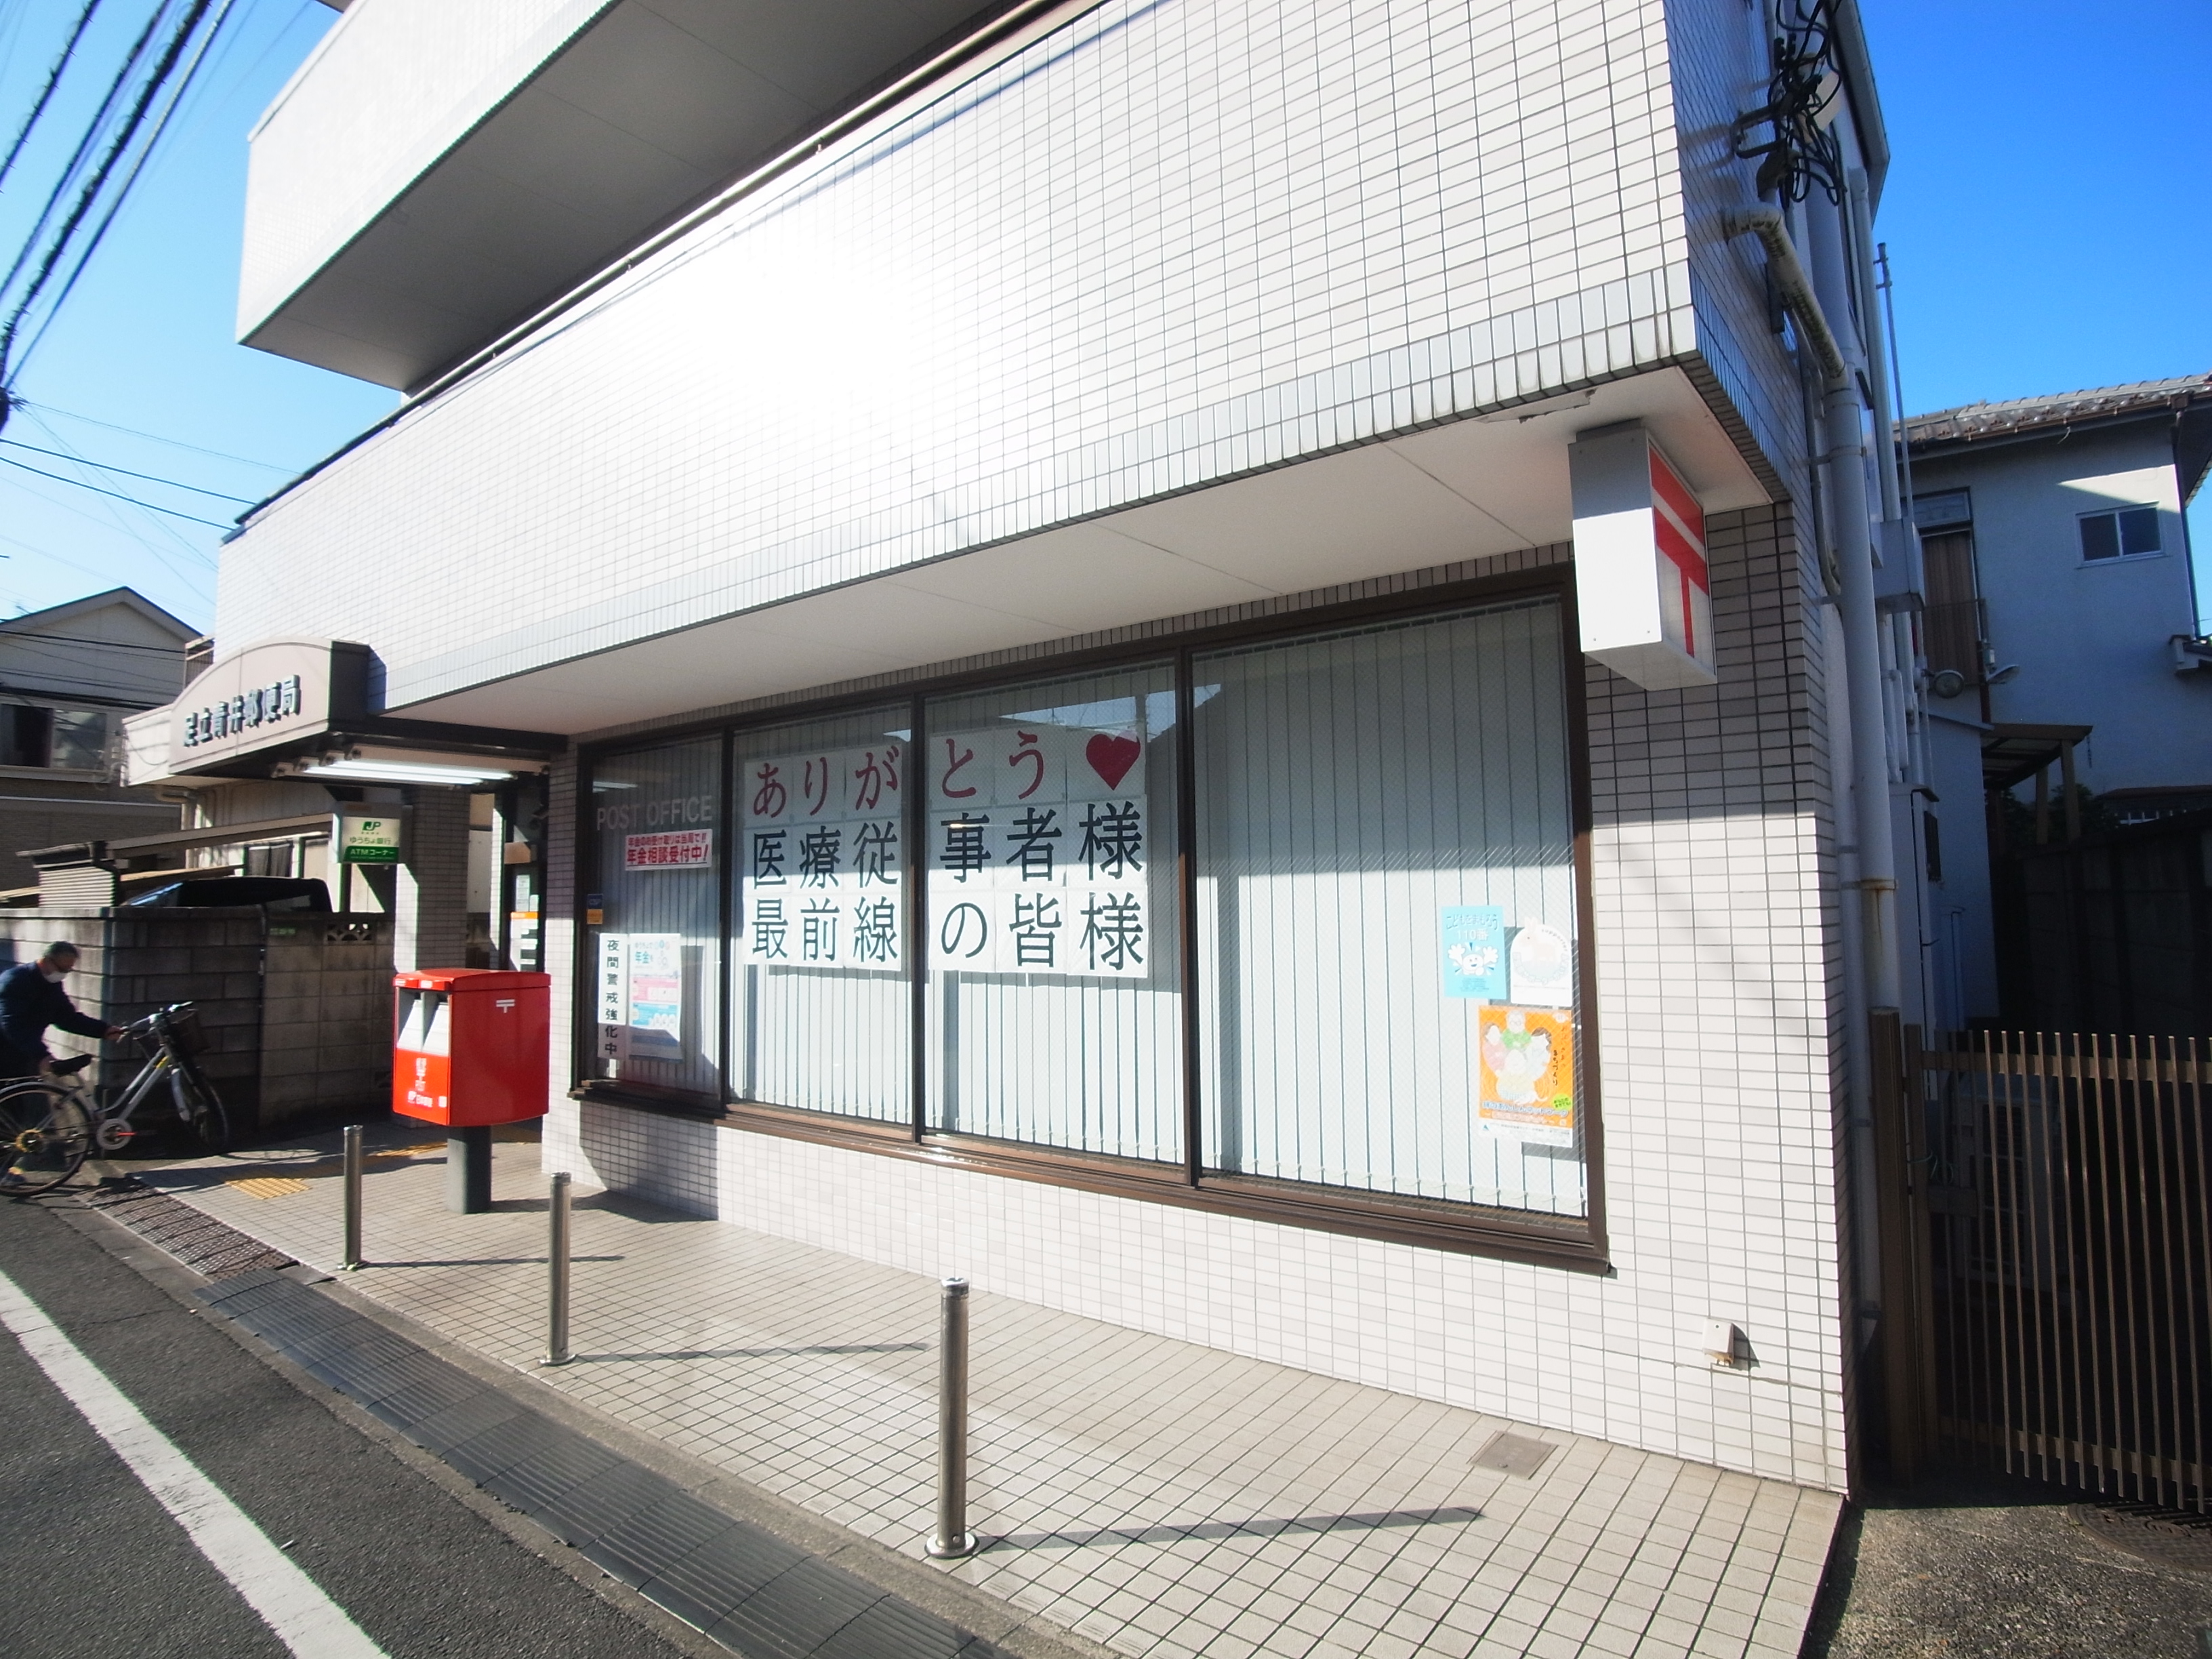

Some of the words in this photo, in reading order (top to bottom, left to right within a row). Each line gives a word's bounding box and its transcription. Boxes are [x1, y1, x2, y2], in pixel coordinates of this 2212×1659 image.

[184, 674, 301, 747] 足立青井郵便局
[753, 730, 1044, 818] ありがとう
[362, 821, 382, 831] JP
[596, 804, 641, 831] POST
[647, 795, 712, 825] OFFICE
[753, 800, 1144, 889] 医療従事者様
[627, 844, 709, 865] 年金相談受付中!
[752, 891, 1145, 970] 最前線の皆様
[1457, 929, 1489, 941] 110番
[605, 940, 619, 1055] 夜間警戒強化中
